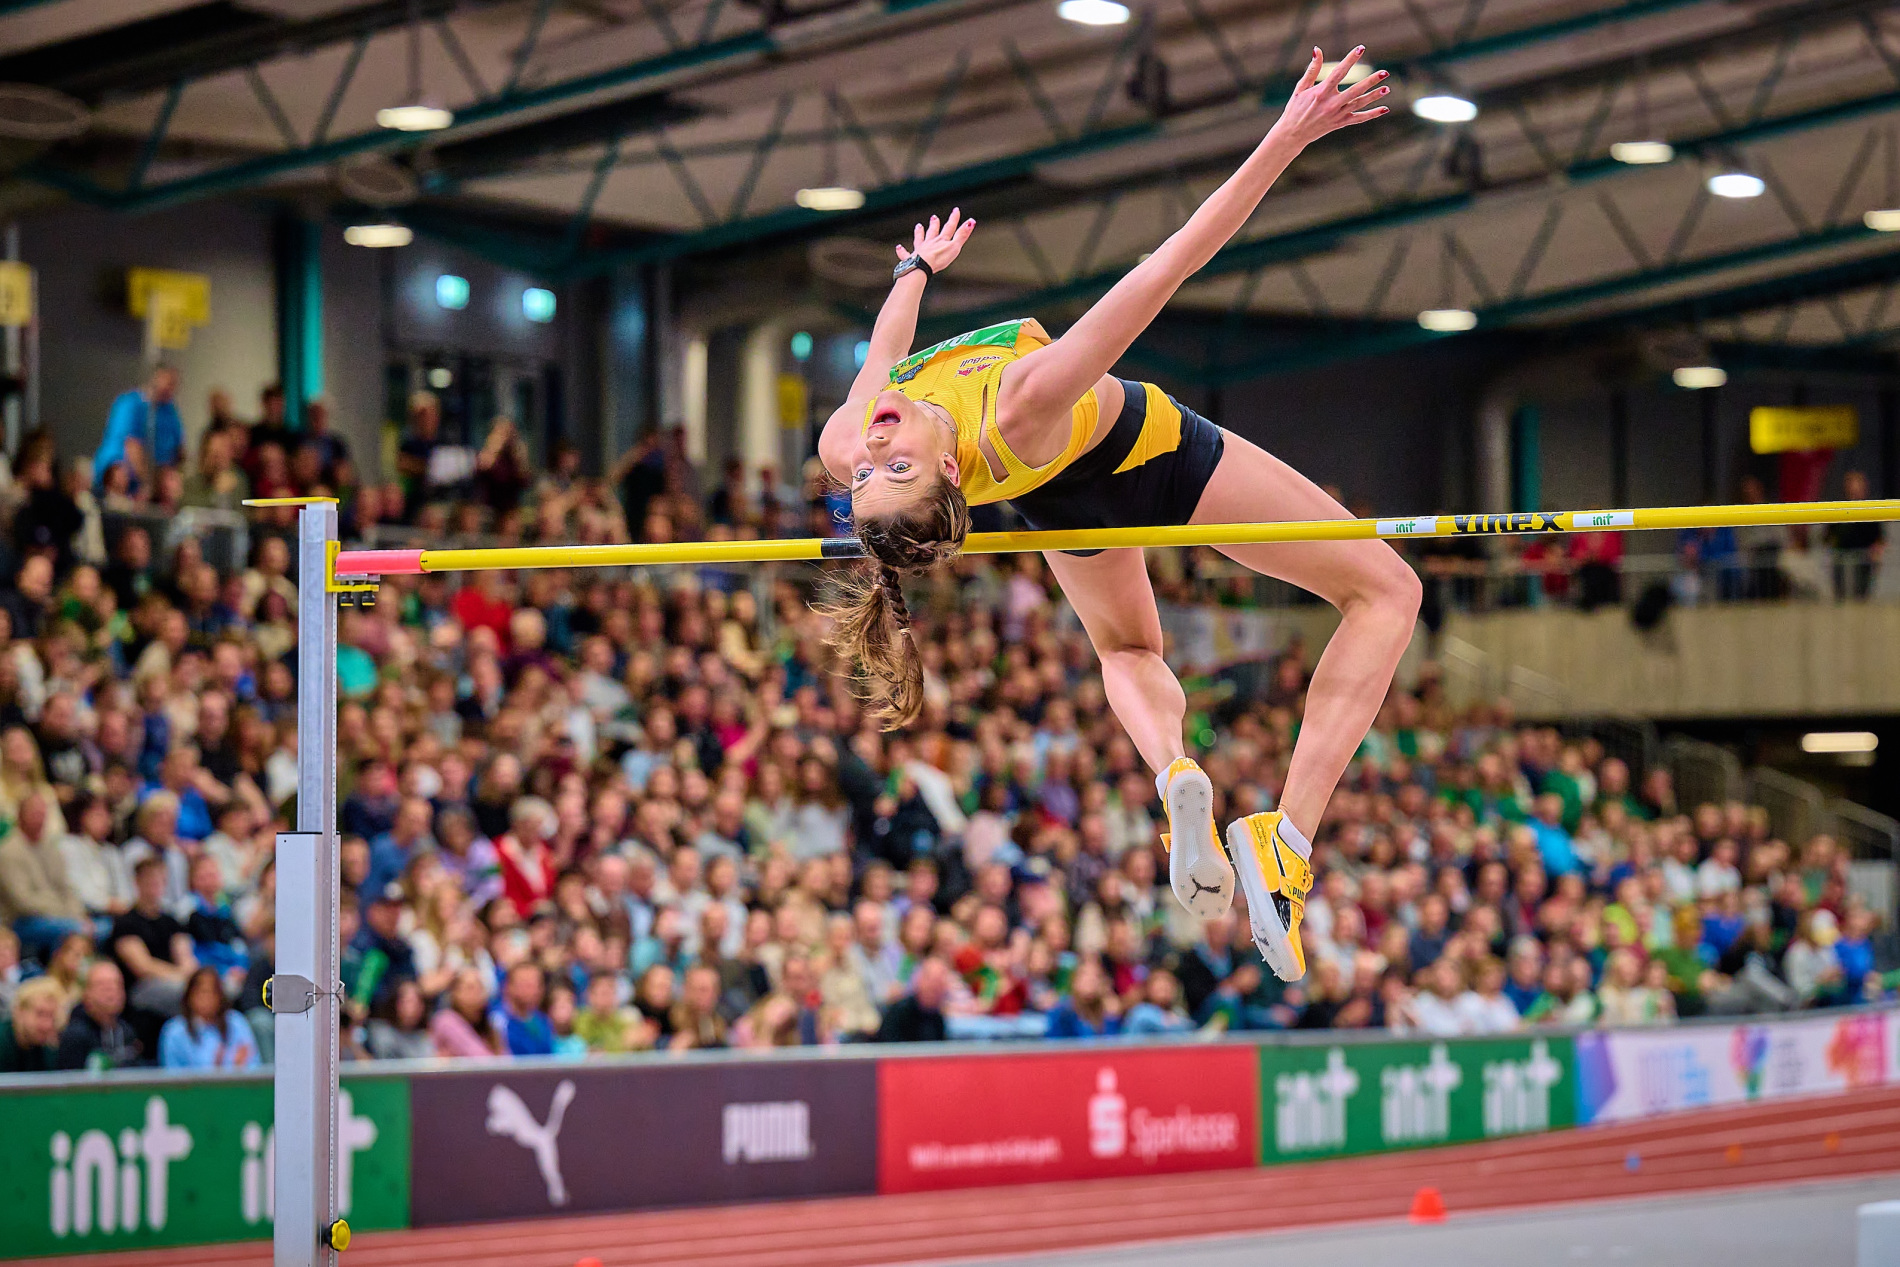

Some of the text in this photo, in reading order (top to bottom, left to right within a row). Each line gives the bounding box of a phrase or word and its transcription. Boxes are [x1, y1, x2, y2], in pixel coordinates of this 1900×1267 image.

[959, 357, 982, 368] Bull
[1395, 521, 1416, 534] init
[1592, 513, 1614, 526] init
[723, 1101, 811, 1165] PUMA
[50, 1095, 194, 1237] init
[240, 1087, 379, 1225] it
